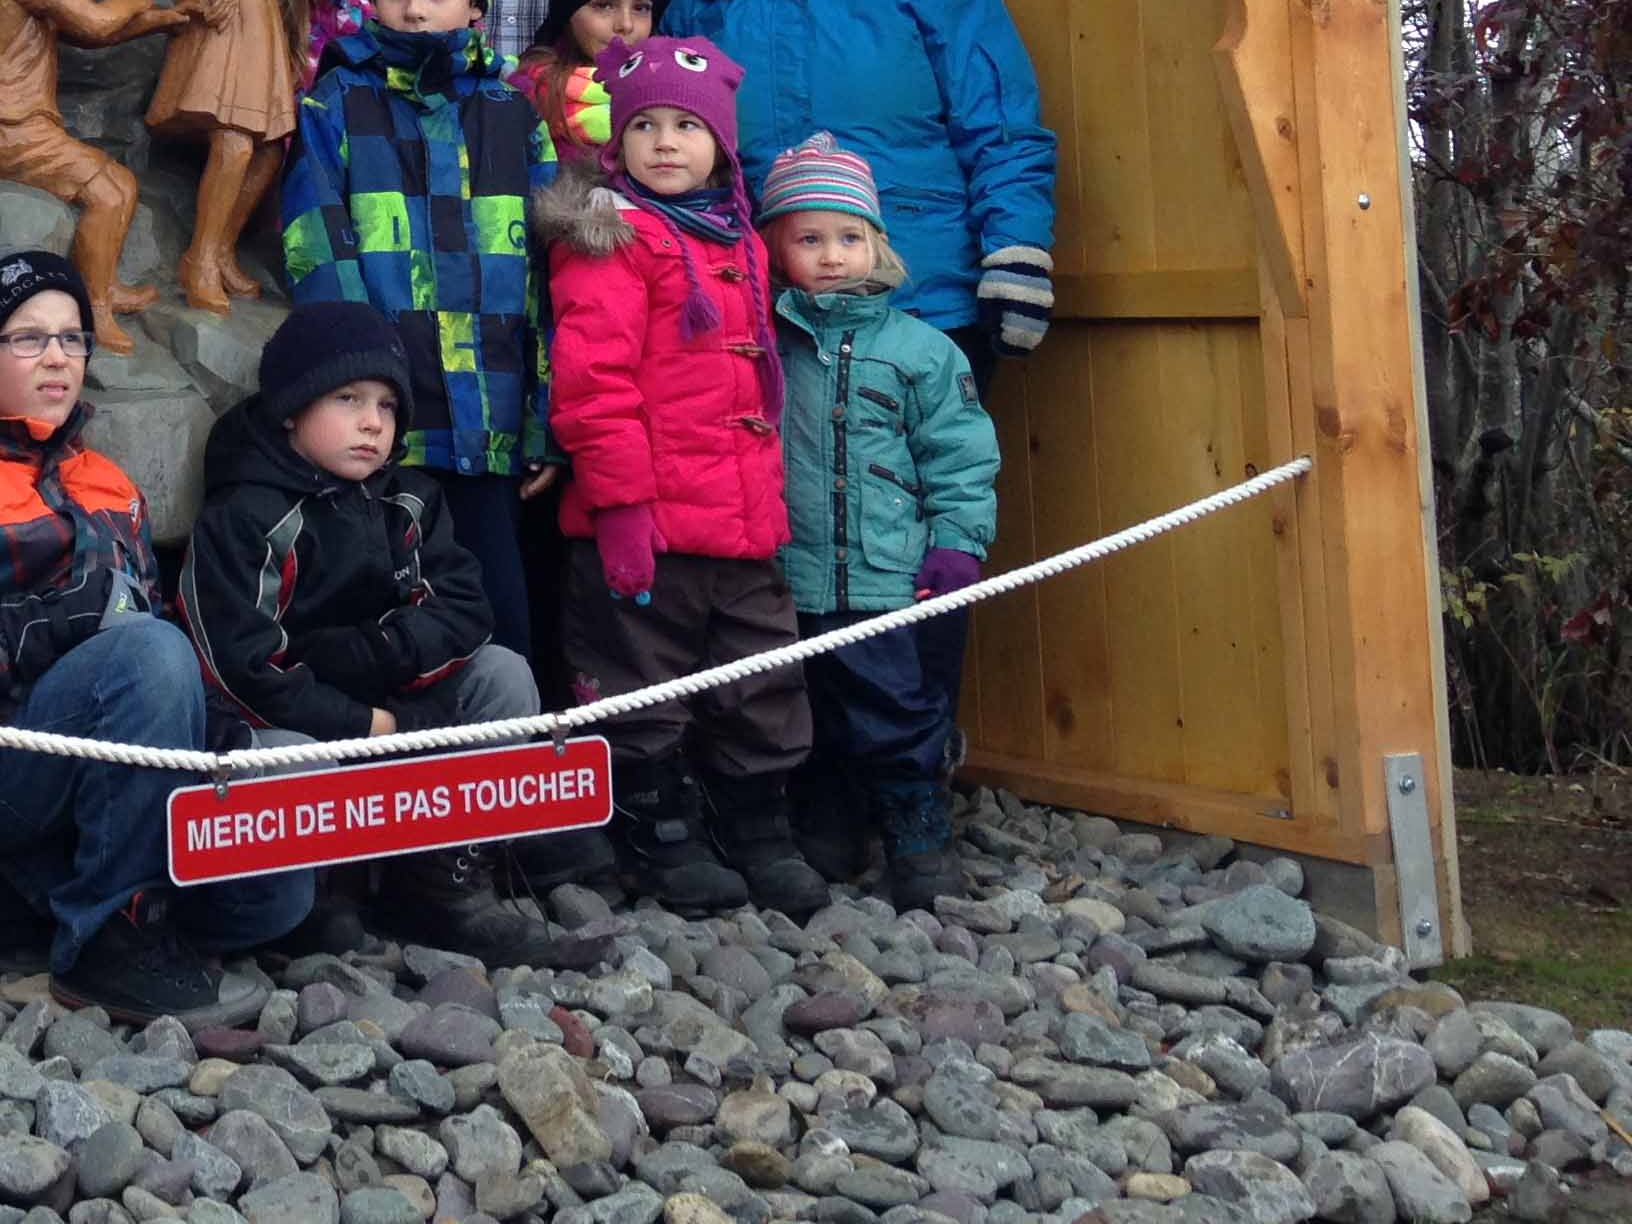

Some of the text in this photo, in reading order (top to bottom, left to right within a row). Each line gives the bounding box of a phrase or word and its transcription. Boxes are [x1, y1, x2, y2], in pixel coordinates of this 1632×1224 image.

[186, 812, 286, 853] MERCI
[295, 803, 337, 837] DE
[345, 793, 385, 829] NE
[394, 785, 451, 823] PAS
[458, 767, 597, 813] TOUCHER
